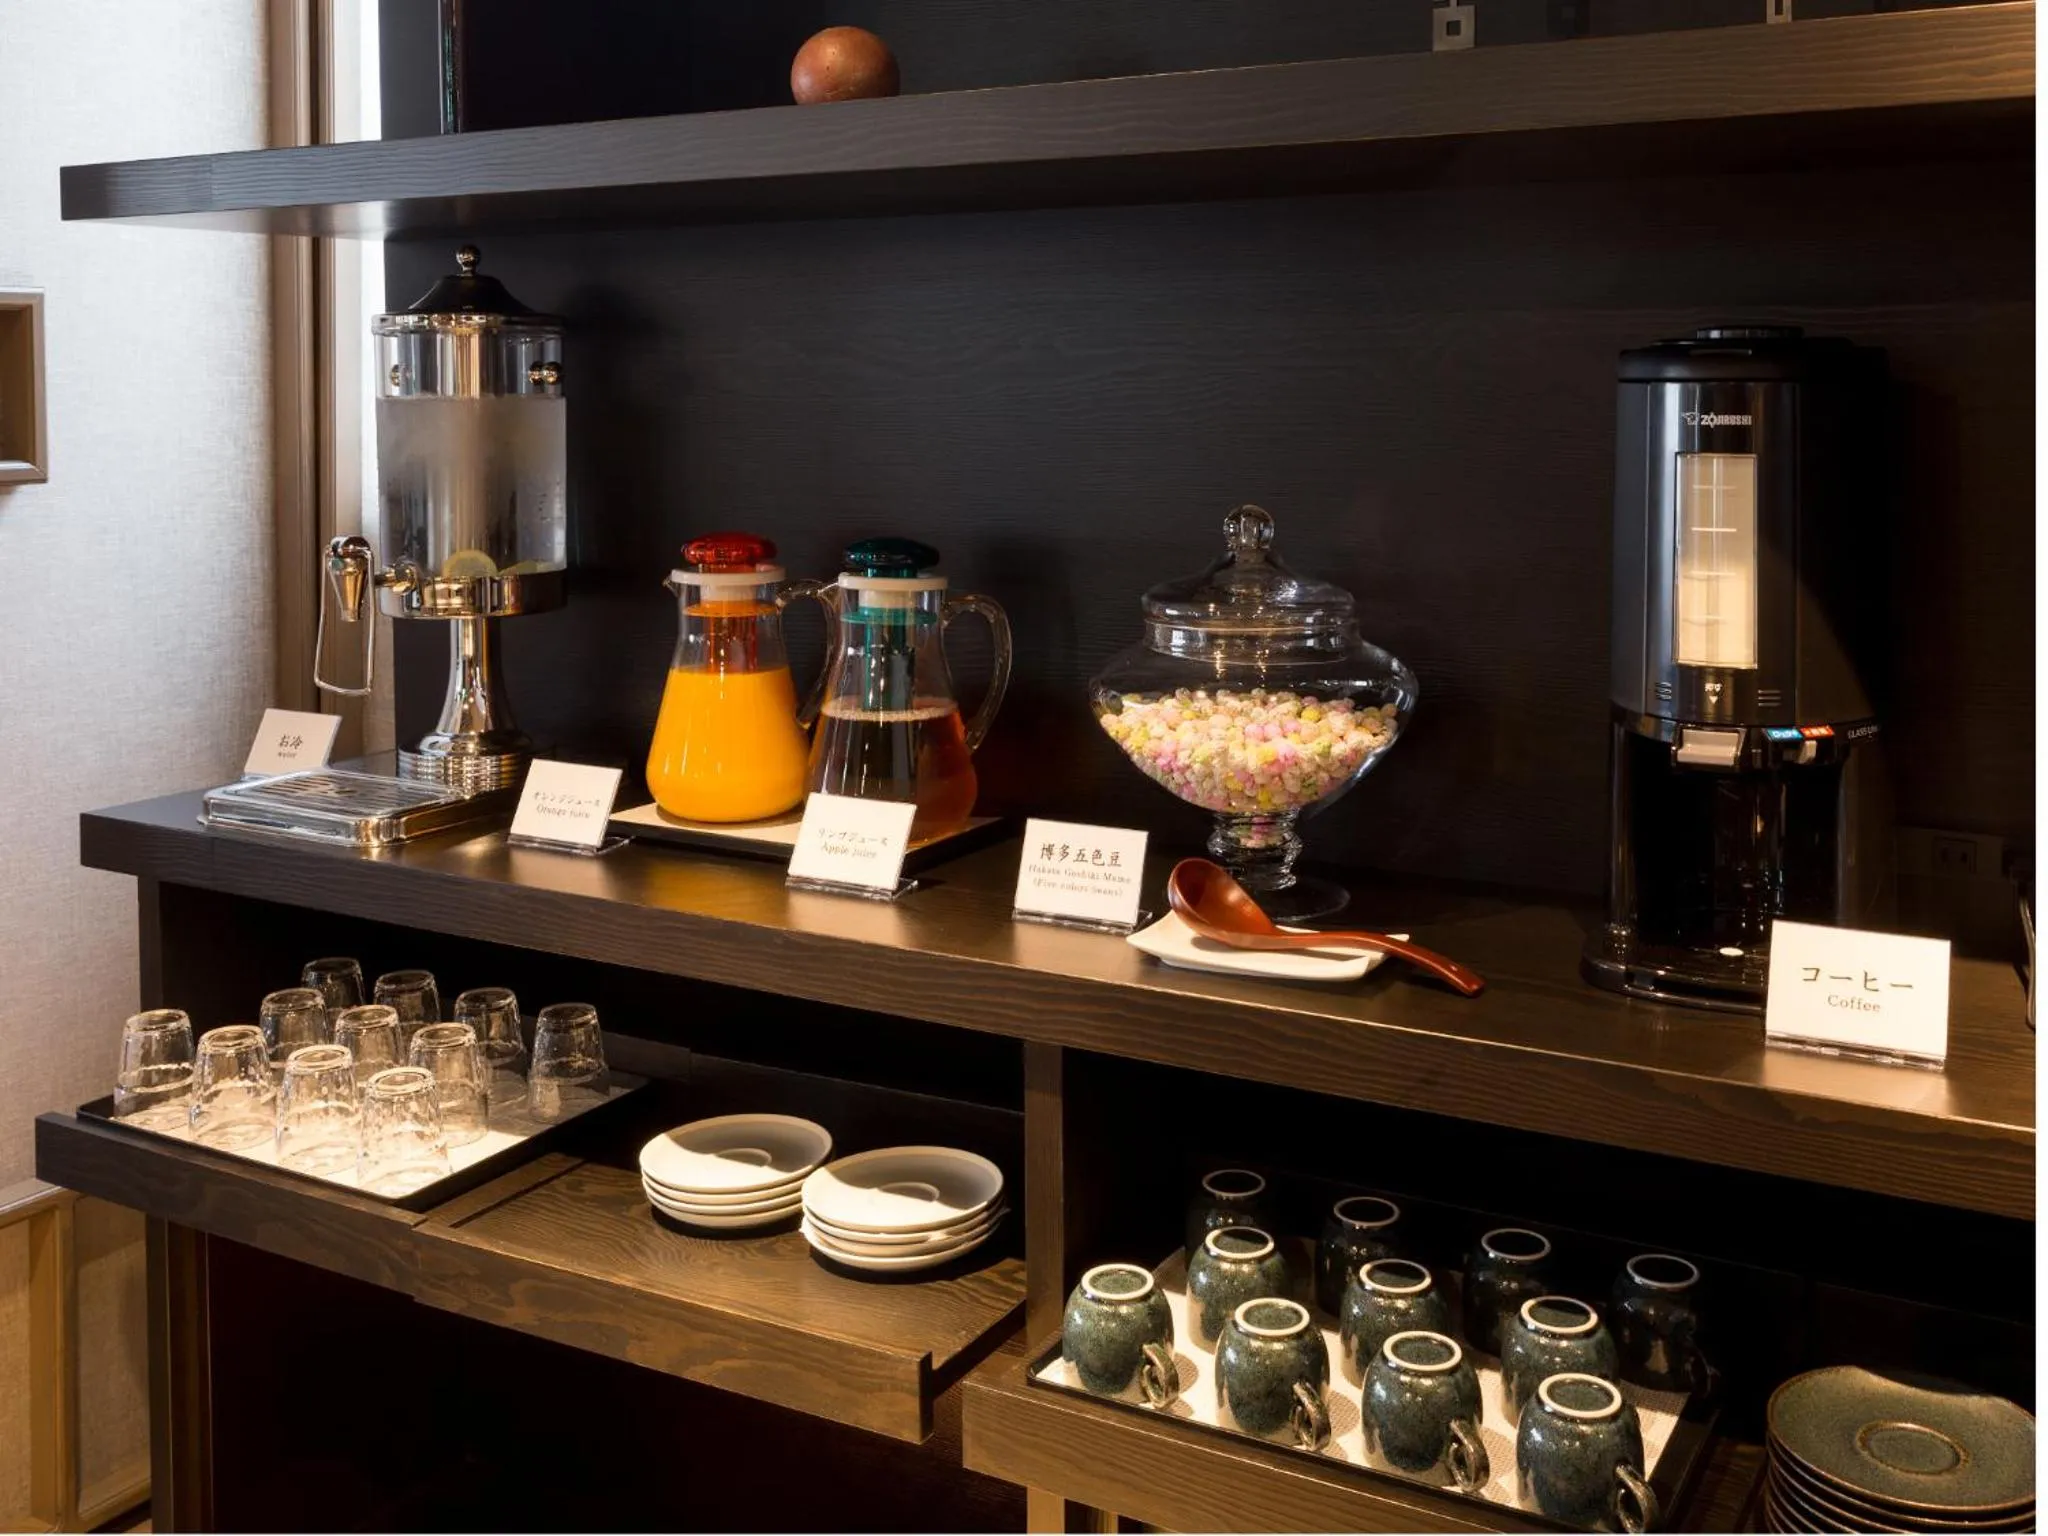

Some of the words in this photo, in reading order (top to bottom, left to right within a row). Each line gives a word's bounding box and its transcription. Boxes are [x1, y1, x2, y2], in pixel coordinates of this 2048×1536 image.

[1040, 843, 1122, 867] 博多五色豆
[1801, 967, 1914, 993] コーヒー
[1827, 994, 1881, 1012] Coffee
